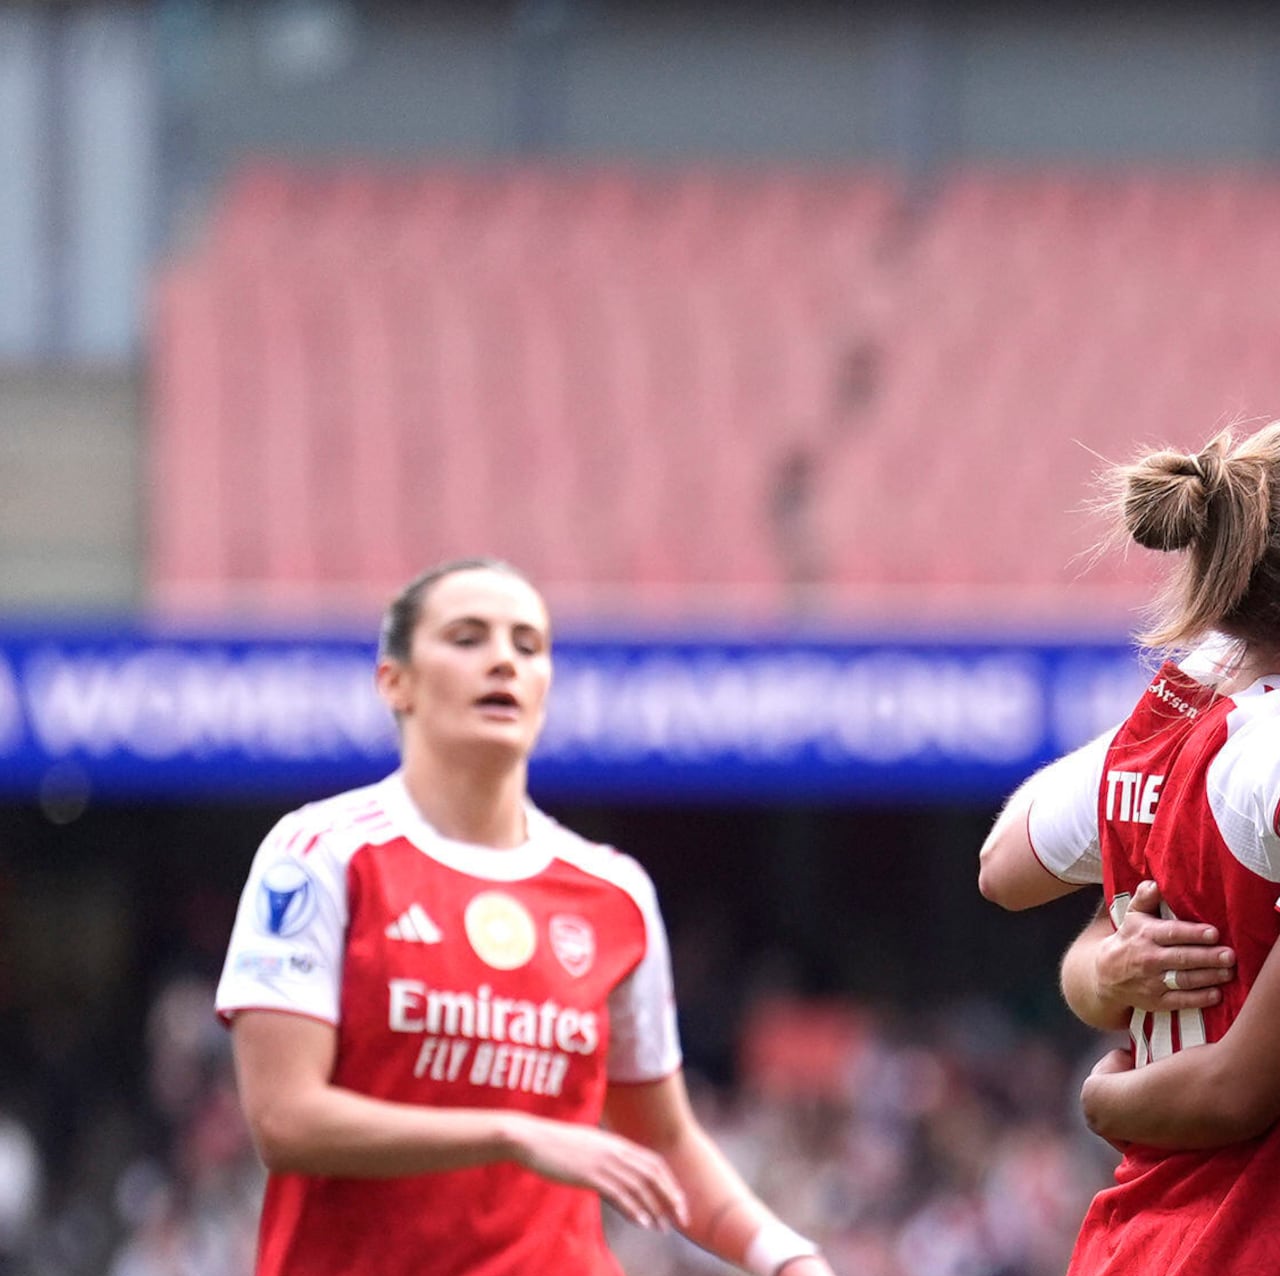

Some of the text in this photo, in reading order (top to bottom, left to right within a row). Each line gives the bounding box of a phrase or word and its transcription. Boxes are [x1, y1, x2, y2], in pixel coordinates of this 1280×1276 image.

[1149, 678, 1200, 720] Arsen
[1105, 769, 1165, 825] TTLE
[388, 979, 599, 1056] Emirates
[414, 1038, 568, 1096] FLY BETTER
